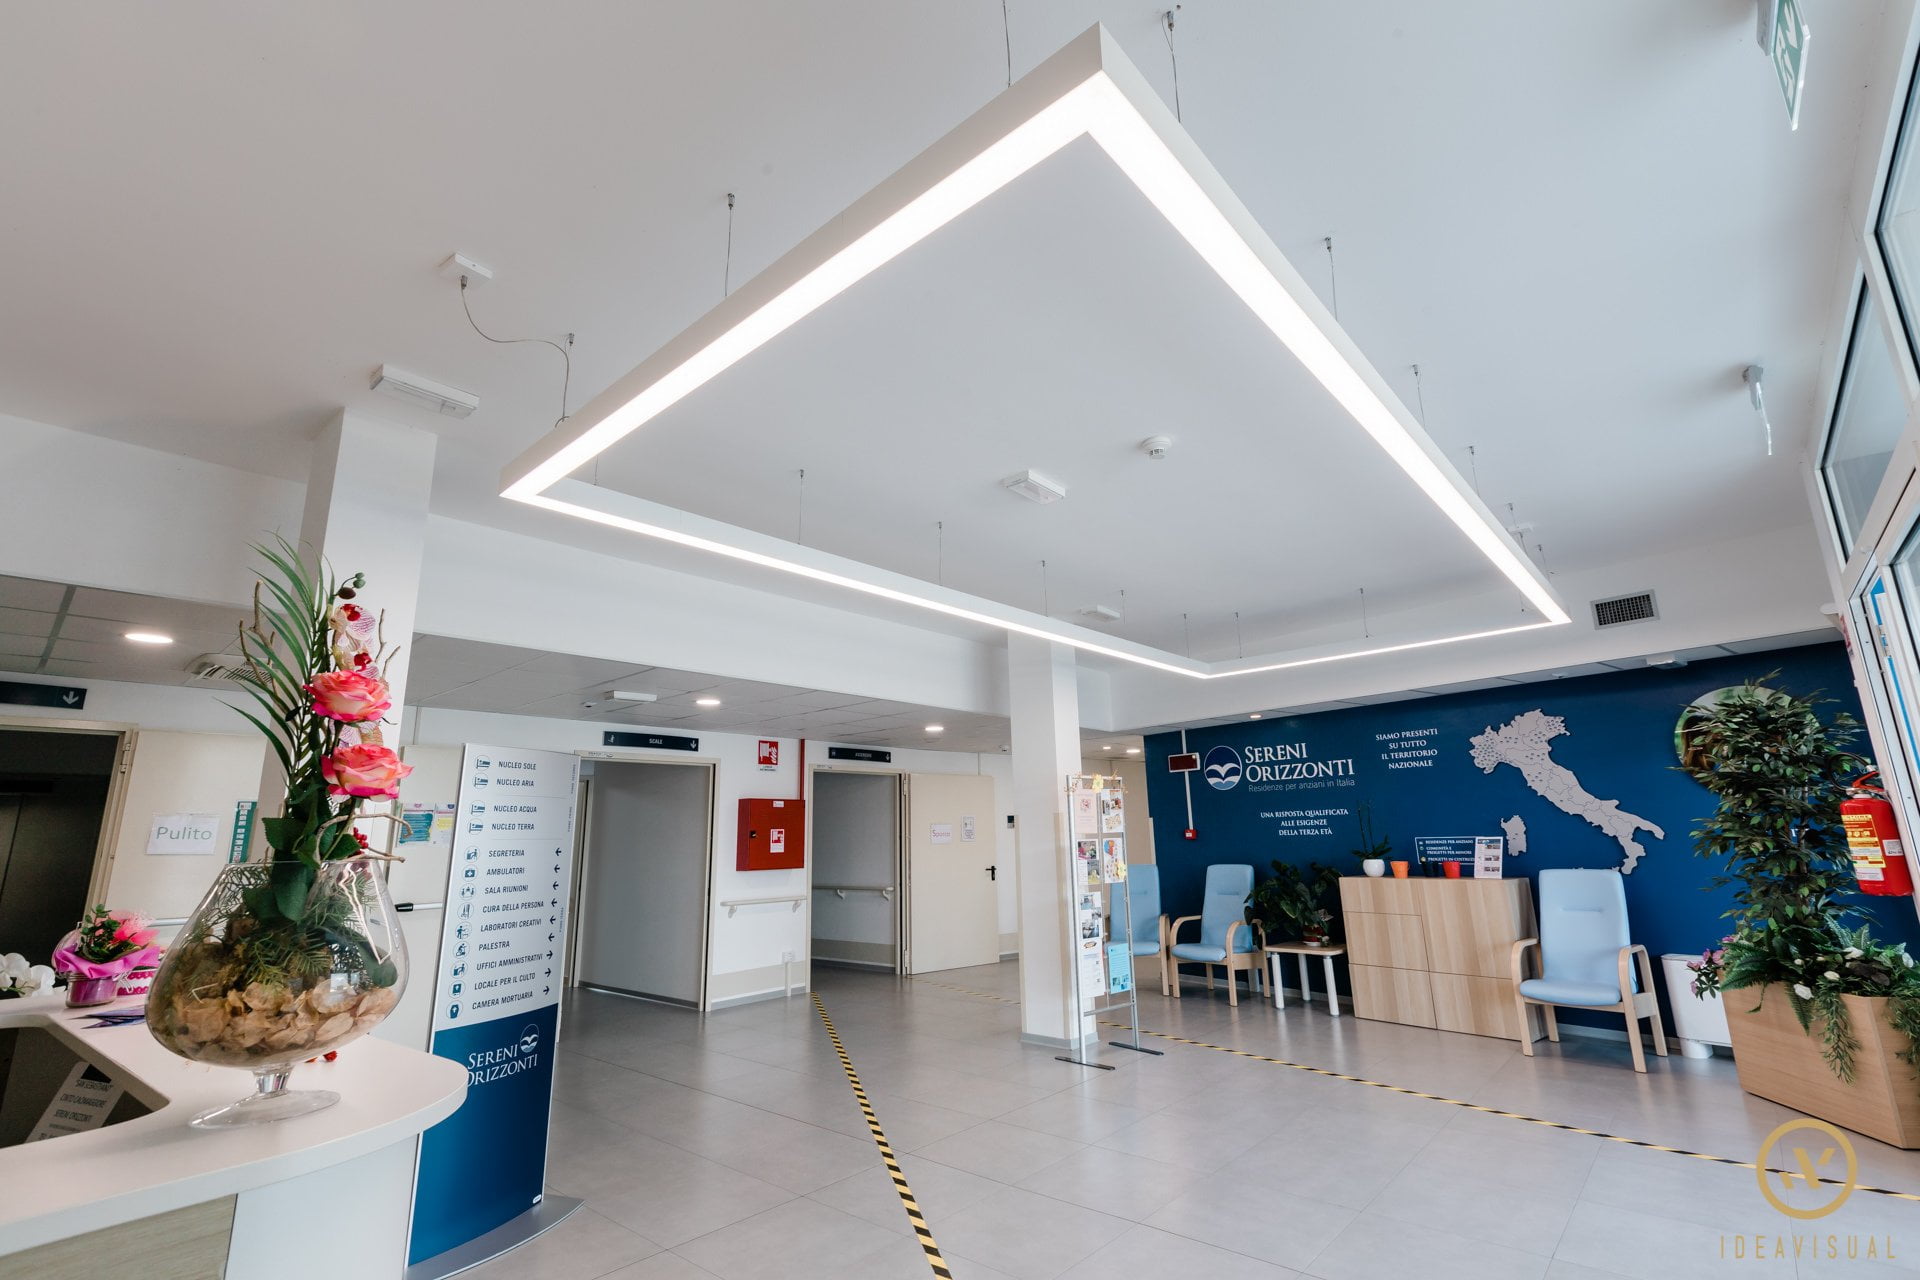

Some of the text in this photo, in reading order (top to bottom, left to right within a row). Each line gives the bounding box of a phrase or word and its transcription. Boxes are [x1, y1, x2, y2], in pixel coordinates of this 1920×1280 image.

[1375, 728, 1438, 741] SIAMO PRESENTI
[1389, 739, 1427, 750] SU TUTTO
[1244, 742, 1308, 764] SERENI
[1390, 748, 1438, 759] TERRITORIO
[498, 761, 522, 769] NUCLEO
[1388, 760, 1433, 769] NAZIONALE
[1245, 759, 1355, 783] ORIZZONTI
[496, 778, 521, 786] NUCLEO
[1248, 778, 1355, 792] Residenze per anziani in Italia
[493, 805, 518, 813] NUCLEO
[1260, 808, 1349, 819] UNA RISPOSTA QUALIFICATA
[491, 823, 535, 831] NUCLEO TERRA
[1299, 828, 1319, 836] TERZA
[1320, 826, 1333, 835] ETÀ
[155, 826, 213, 841] Pulito
[488, 849, 525, 858] SEGRETERIA
[486, 867, 525, 876] AMBULATORI
[484, 884, 529, 895] SALA RIUNIONI
[482, 900, 544, 913] CURA DELLA PERSONA
[480, 918, 542, 932] LABORATORI CREATIVI
[478, 940, 510, 951] PALESTRA
[476, 953, 543, 971] UFFICI AMMINISTRATIVI
[474, 972, 536, 991] LOCALE PER IL CULTO
[472, 990, 534, 1010] CAMERA MORTUARIA
[467, 1044, 518, 1070] SERENI
